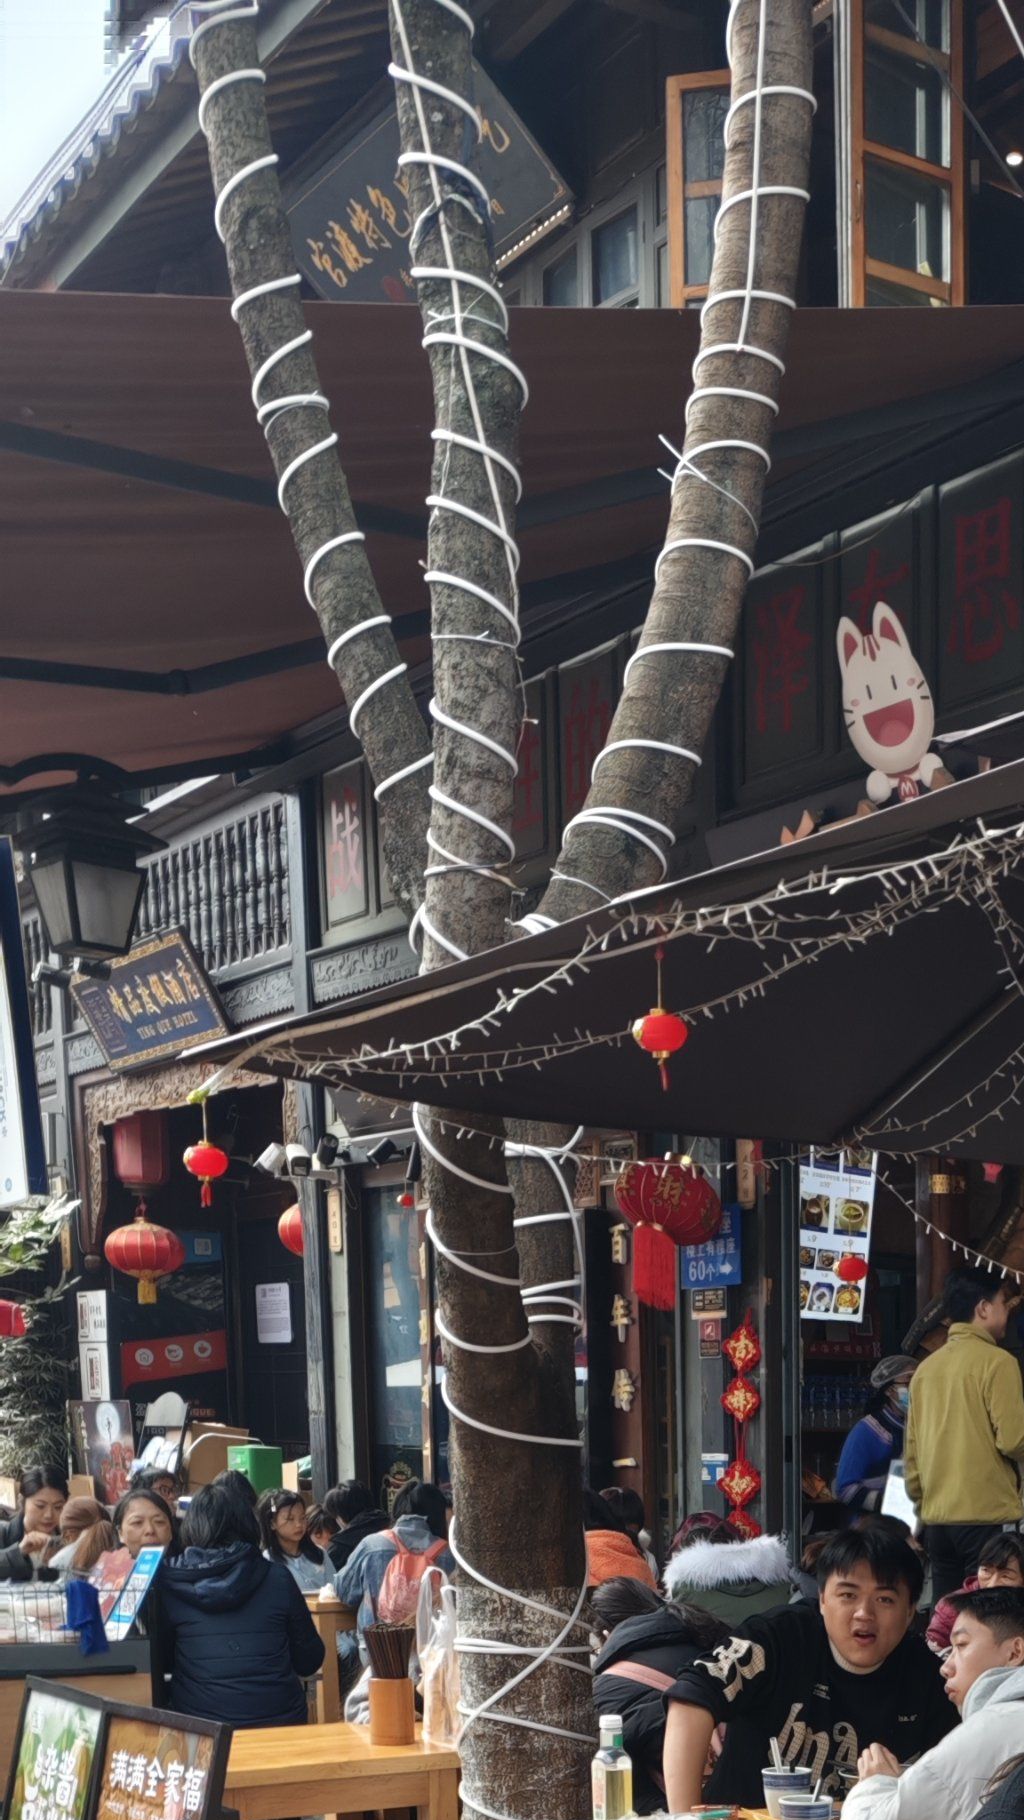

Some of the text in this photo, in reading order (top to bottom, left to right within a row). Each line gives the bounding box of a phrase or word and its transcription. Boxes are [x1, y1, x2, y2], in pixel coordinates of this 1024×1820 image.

[109, 1749, 206, 1811] 满满全家福
